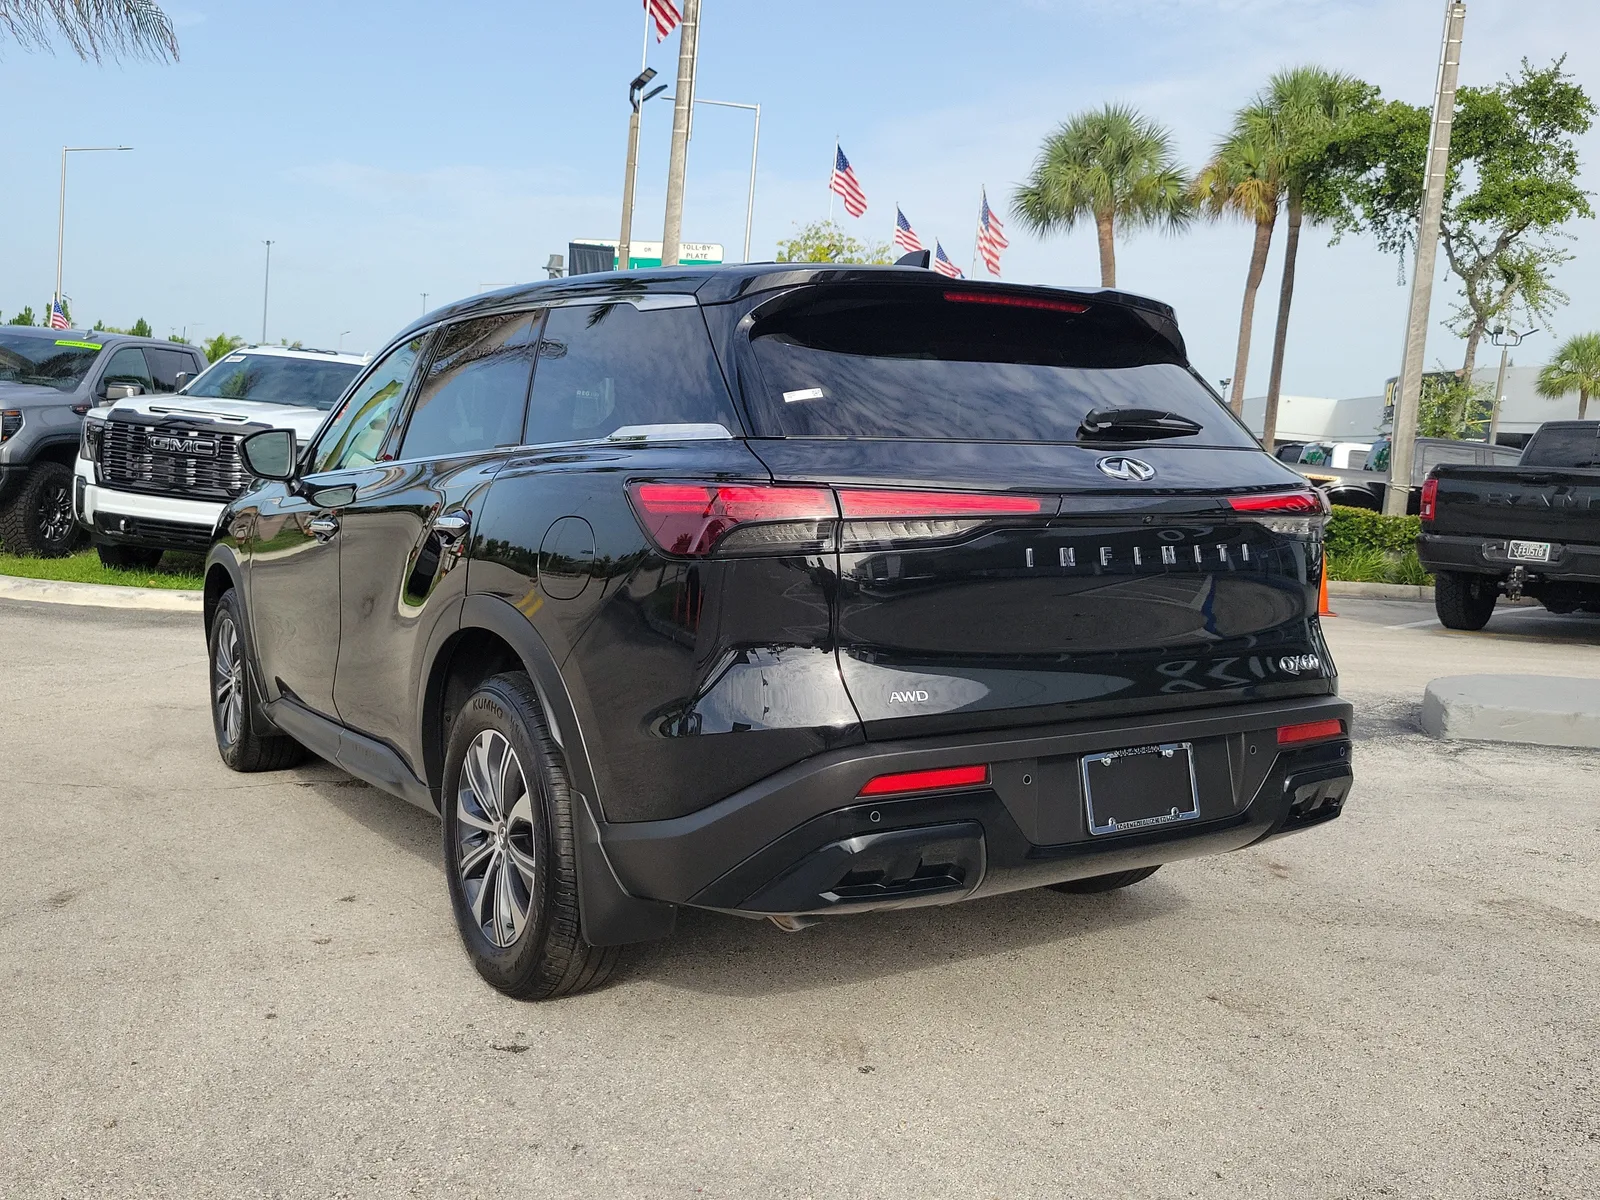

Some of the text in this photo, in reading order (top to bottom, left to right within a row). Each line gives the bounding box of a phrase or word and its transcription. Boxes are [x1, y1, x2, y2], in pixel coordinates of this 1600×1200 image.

[150, 436, 217, 455] GMC
[1487, 492, 1592, 509] RAM
[1025, 543, 1250, 568] INFINITI
[1279, 653, 1319, 676] QX60
[889, 690, 929, 704] AWD
[473, 698, 504, 719] KUMHO
